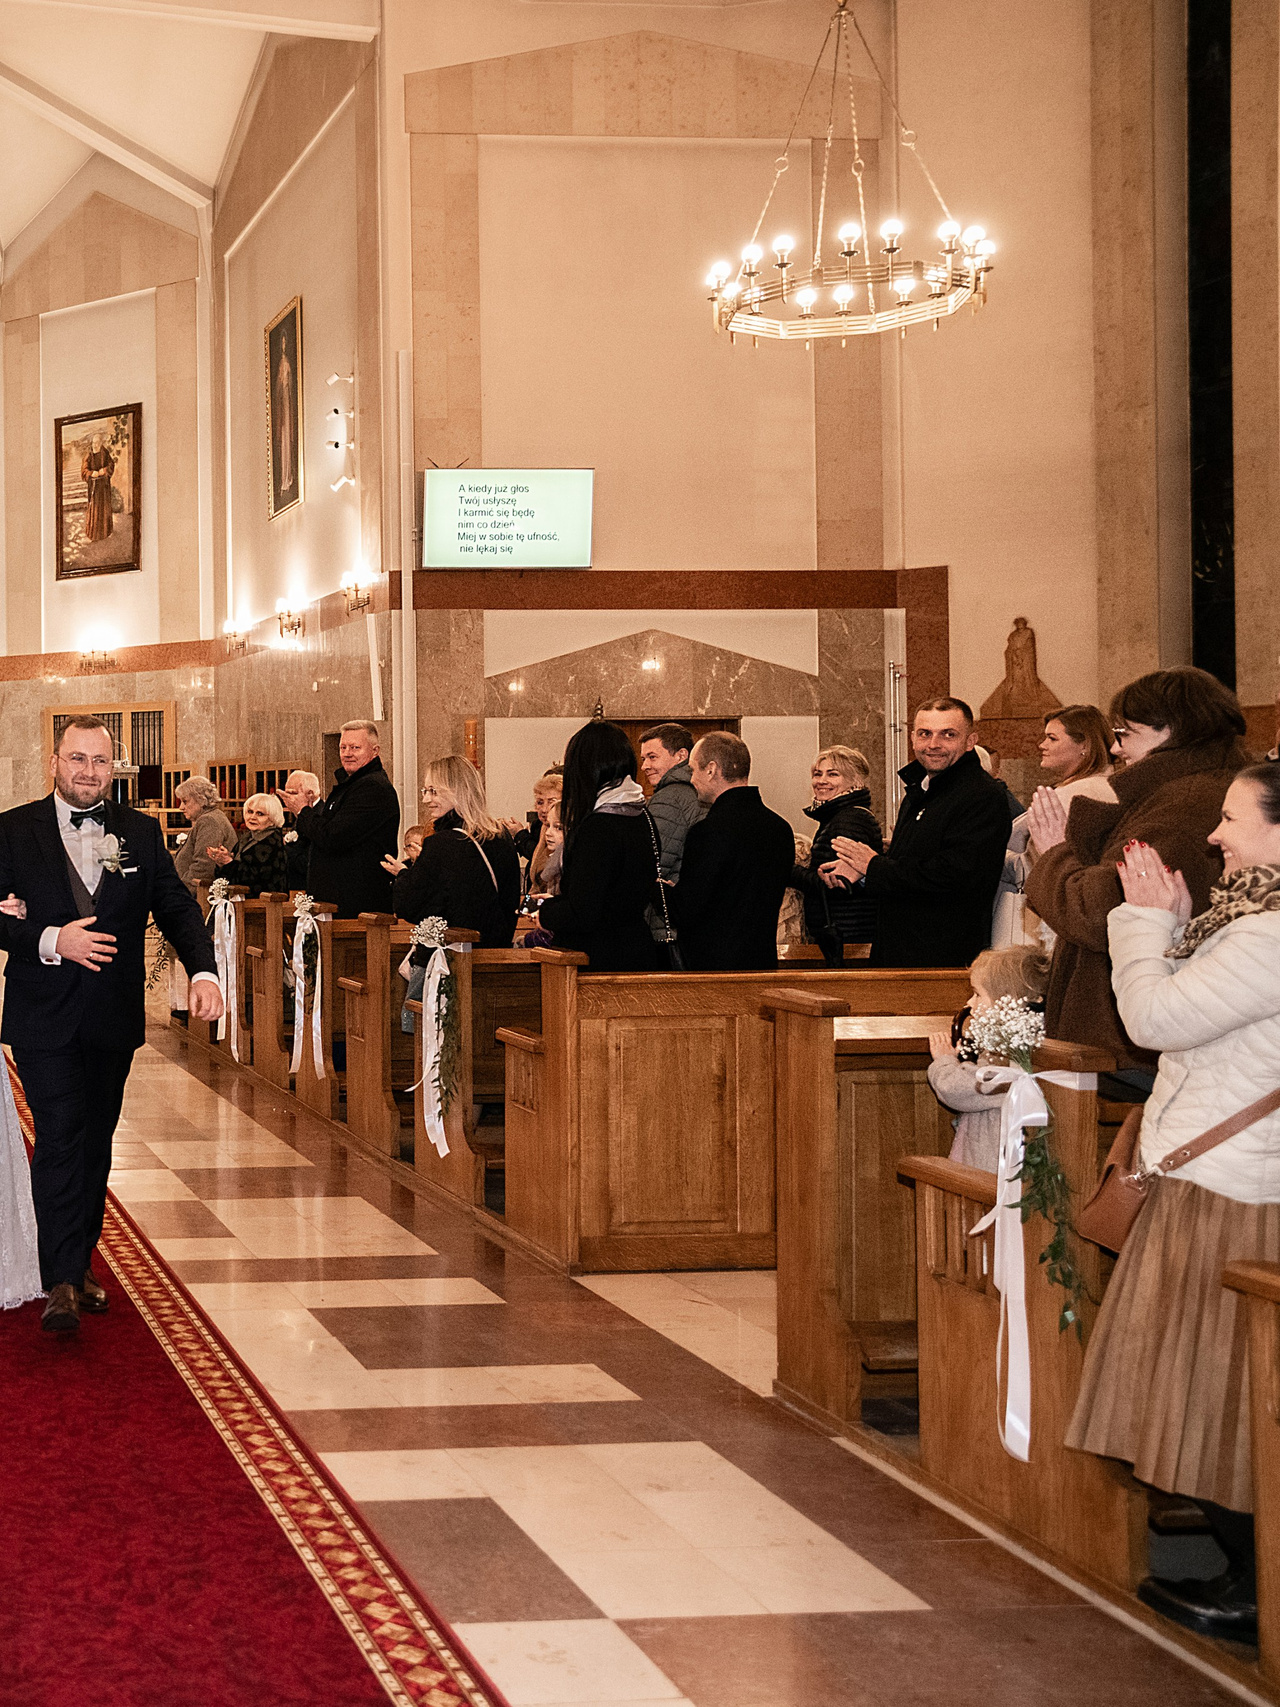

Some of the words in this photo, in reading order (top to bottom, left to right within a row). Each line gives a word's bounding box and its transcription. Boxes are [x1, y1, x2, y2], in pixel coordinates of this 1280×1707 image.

[468, 484, 492, 495] kiedy
[494, 484, 508, 494] już
[511, 485, 530, 495] głos
[459, 496, 480, 506] Twój
[483, 497, 517, 506] usłyszę
[464, 508, 494, 517] karmić
[497, 509, 510, 518] się
[512, 508, 535, 518] będę
[458, 520, 474, 528] nim
[458, 532, 477, 542] Miej
[489, 532, 514, 541] sobie
[516, 534, 525, 542] tę
[527, 532, 560, 541] ufność,
[460, 544, 473, 552] nie
[476, 544, 498, 554] lękaj
[500, 544, 513, 554] się
